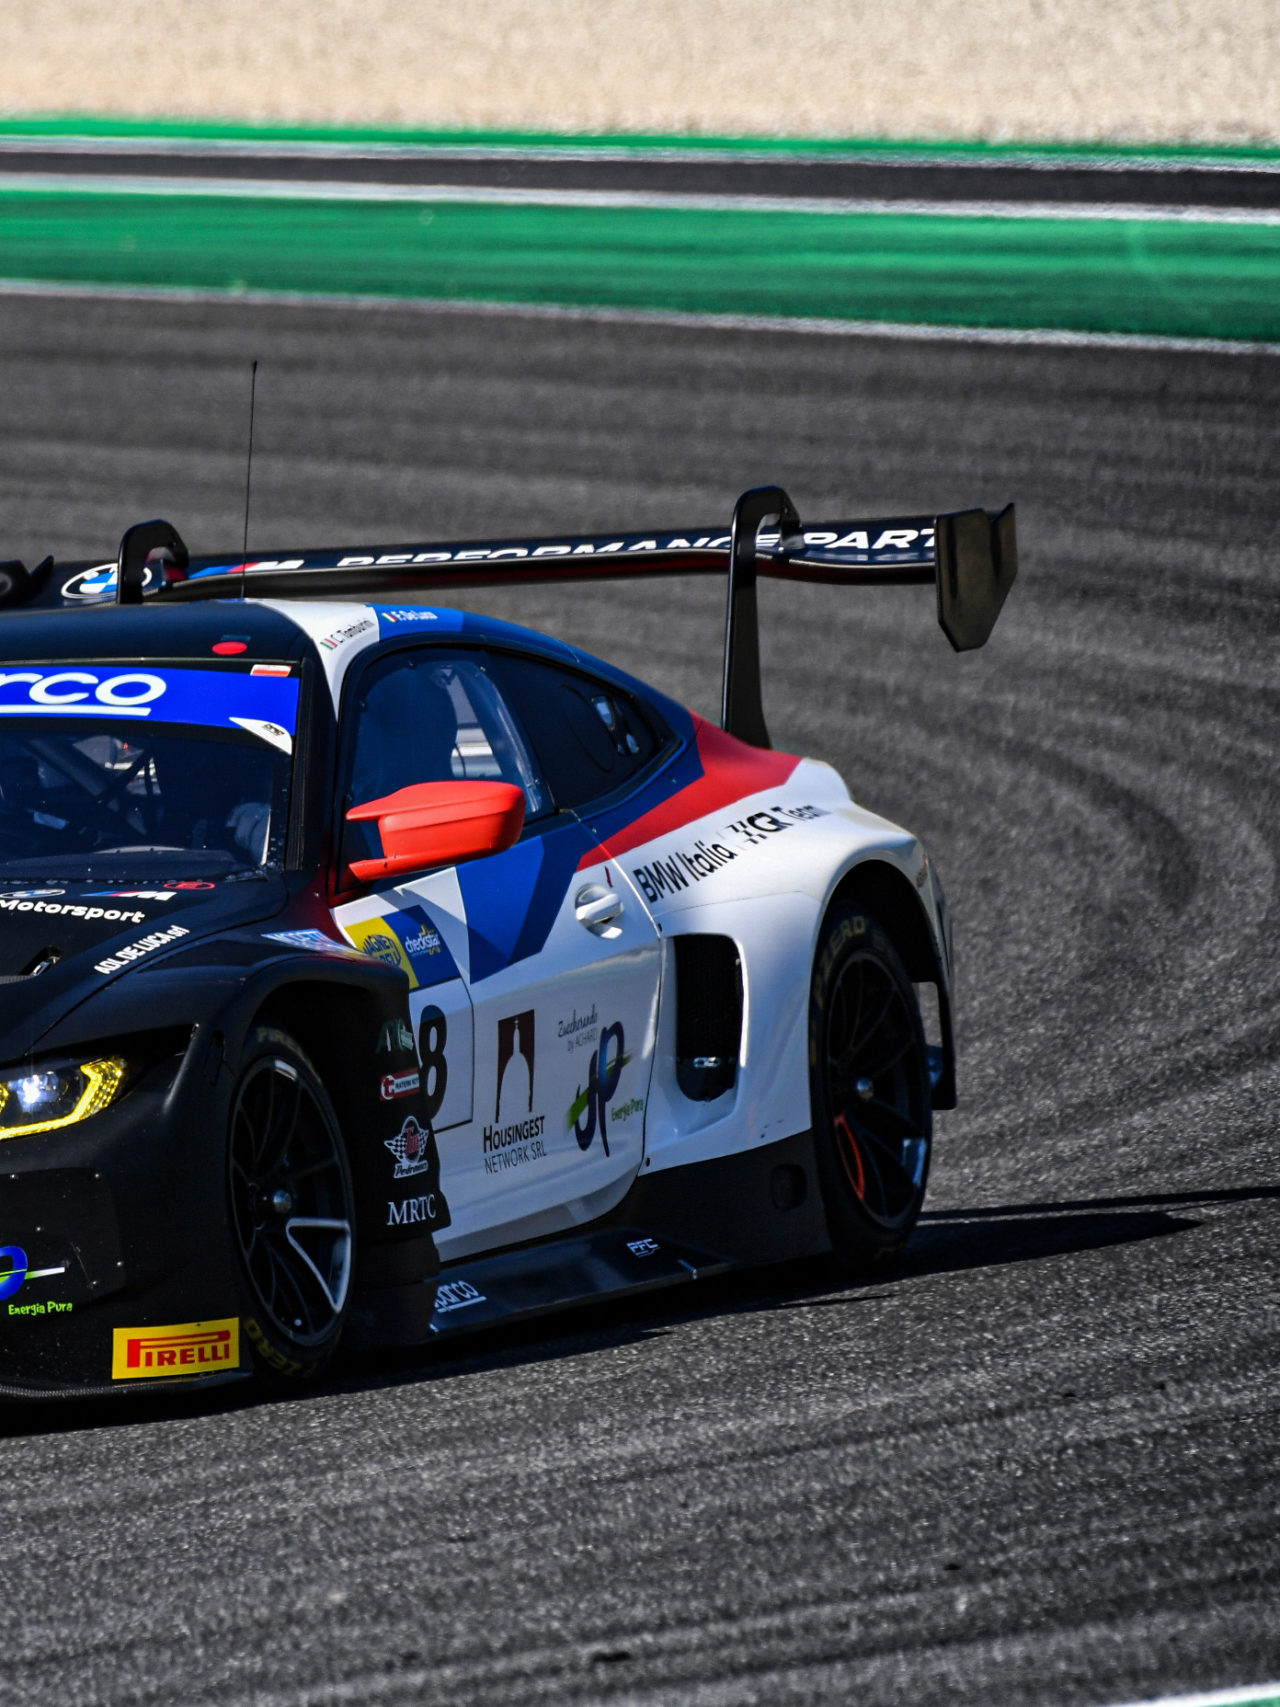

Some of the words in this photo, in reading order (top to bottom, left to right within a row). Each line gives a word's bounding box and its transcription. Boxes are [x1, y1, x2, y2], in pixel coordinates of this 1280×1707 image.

[803, 528, 935, 550] PART
[632, 855, 690, 903] BMW
[675, 840, 738, 882] Italia
[132, 931, 177, 953] LUCA
[418, 1004, 448, 1122] 8
[483, 1115, 545, 1153] HOUSINGEST
[484, 1144, 530, 1175] NETWORK
[530, 1140, 548, 1160] SRL
[386, 1193, 436, 1226] MRTC
[626, 1238, 660, 1252] PFC
[8, 1303, 45, 1316] Energia
[47, 1301, 73, 1313] Pura
[434, 1280, 480, 1312] parco
[126, 1329, 231, 1368] PIRELLI
